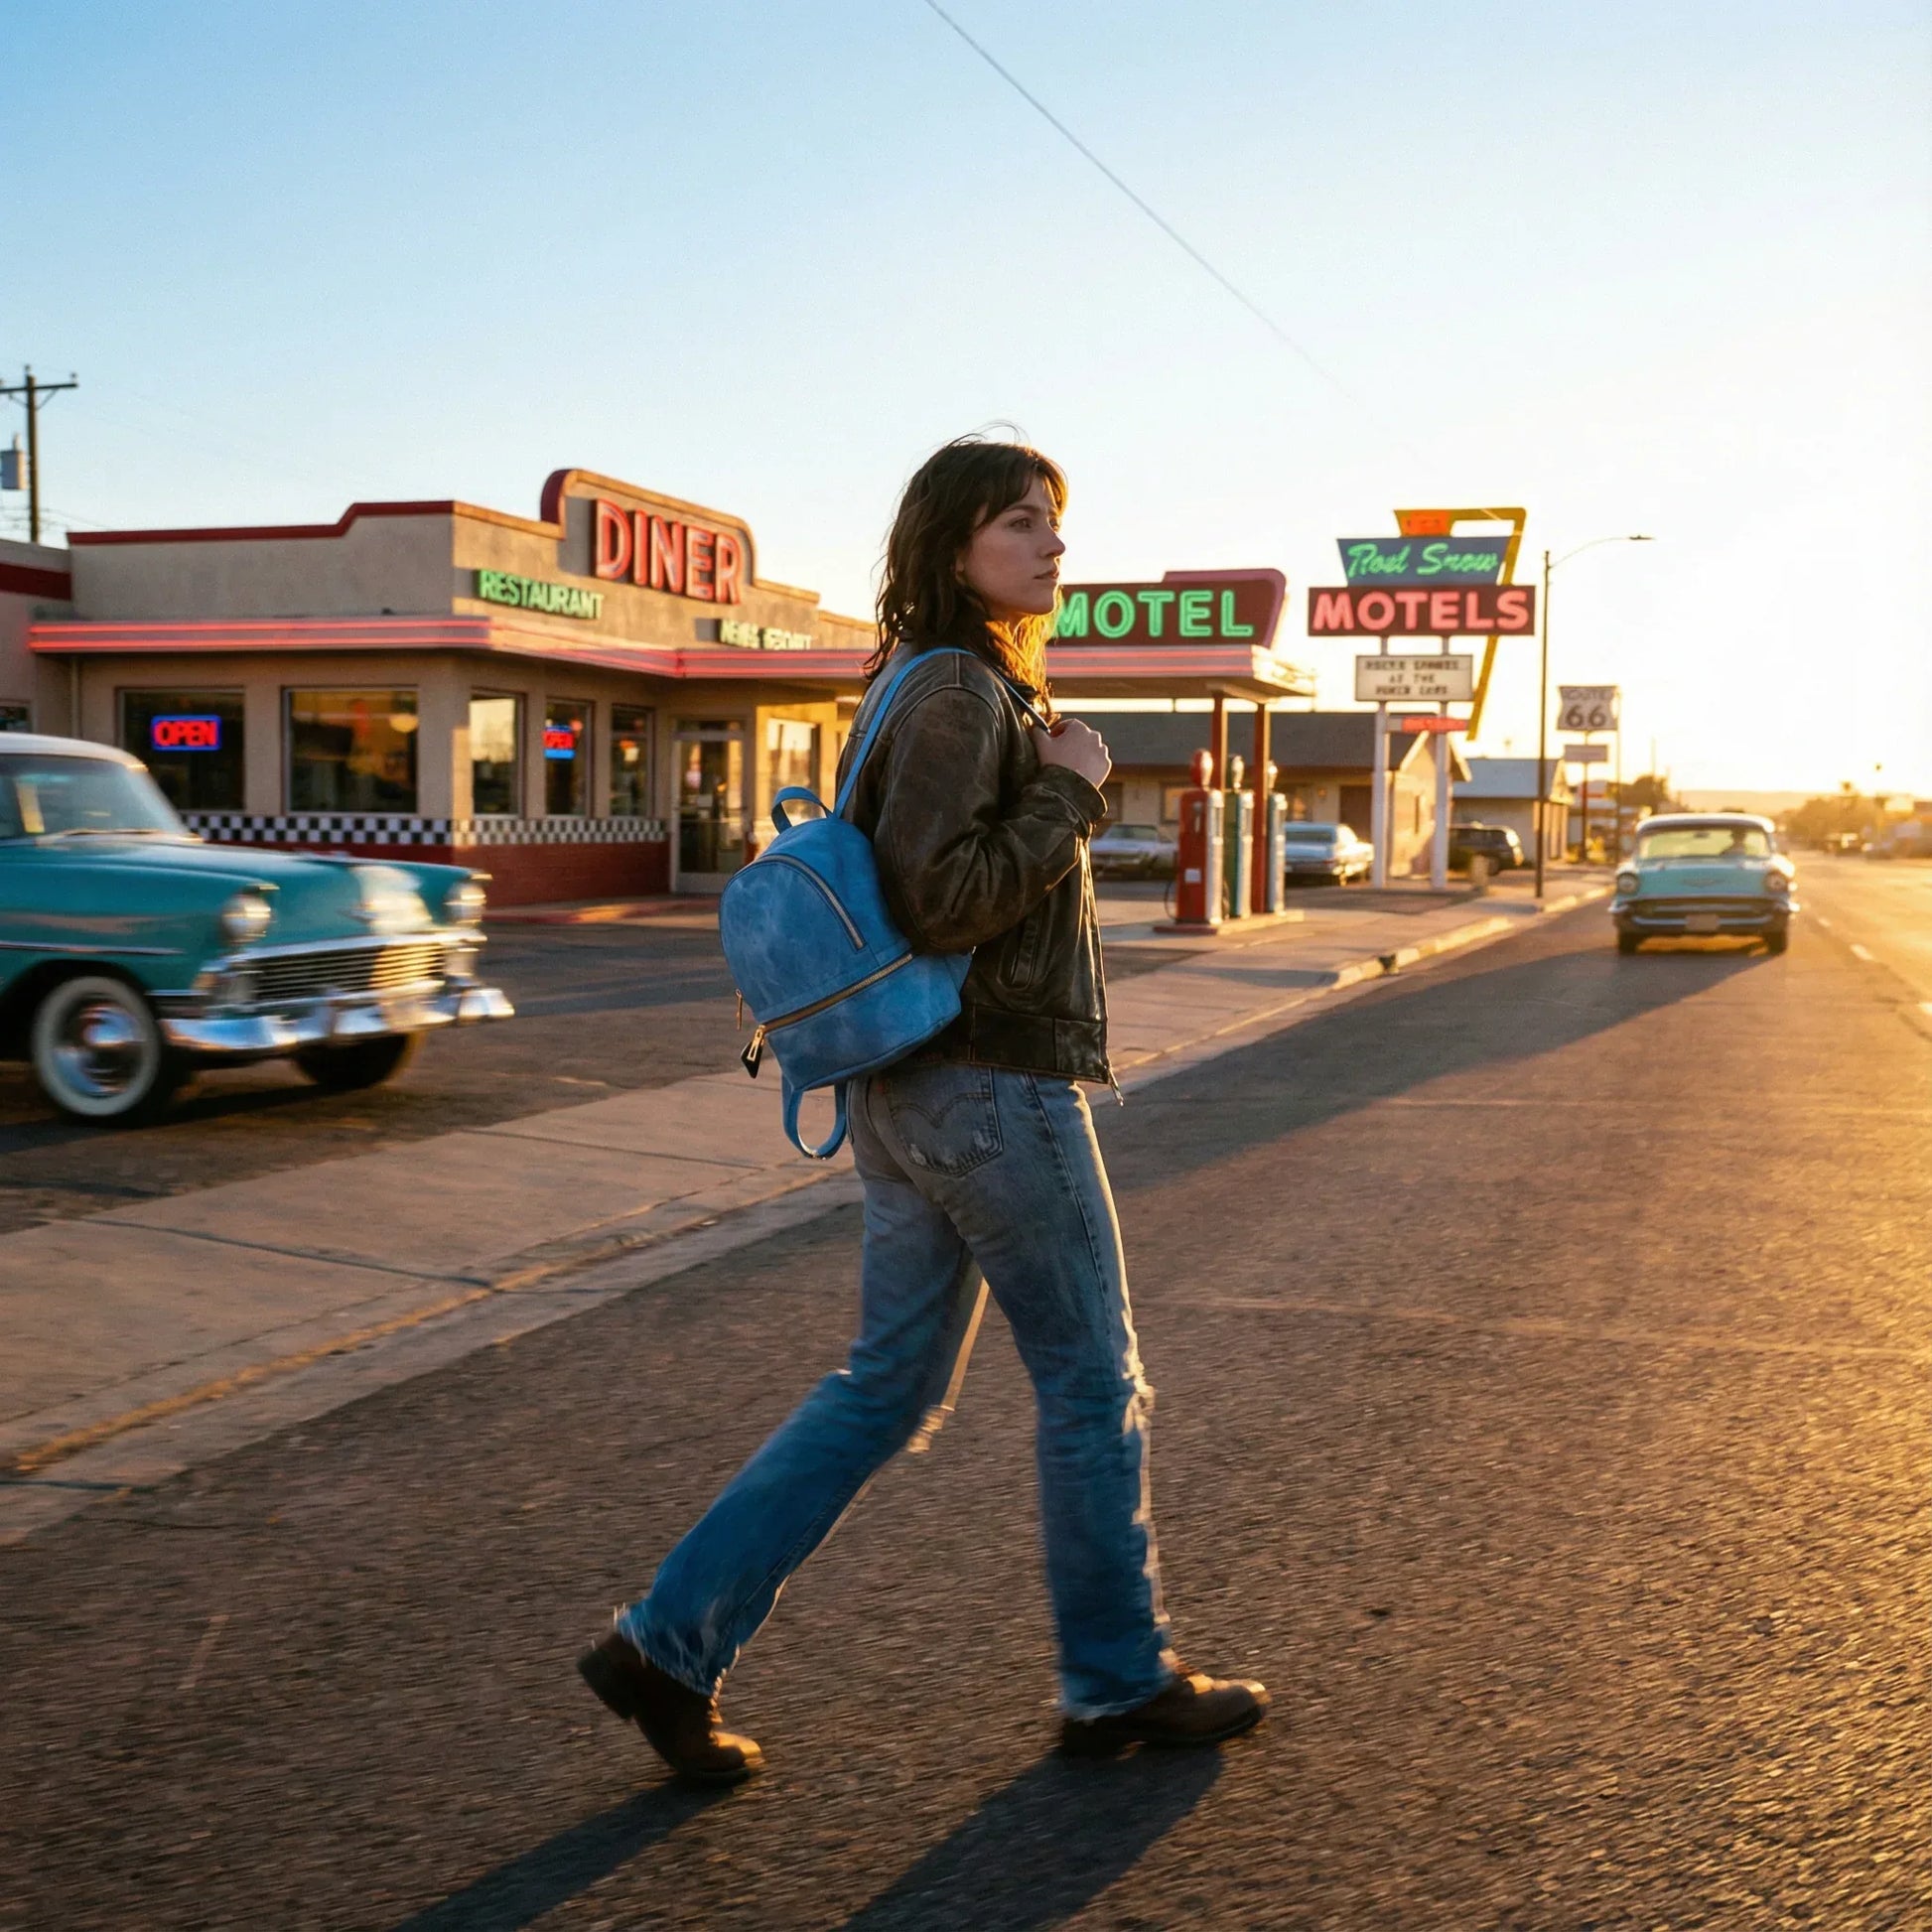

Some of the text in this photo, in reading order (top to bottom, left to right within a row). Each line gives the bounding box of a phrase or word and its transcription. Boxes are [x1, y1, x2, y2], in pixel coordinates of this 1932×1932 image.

[596, 497, 742, 605] DINER
[479, 568, 604, 619] RESTAURANT
[1055, 589, 1255, 638] MOTEL
[1311, 590, 1530, 631] MOTELS
[154, 721, 217, 747] OPEN
[1566, 705, 1607, 728] 66
